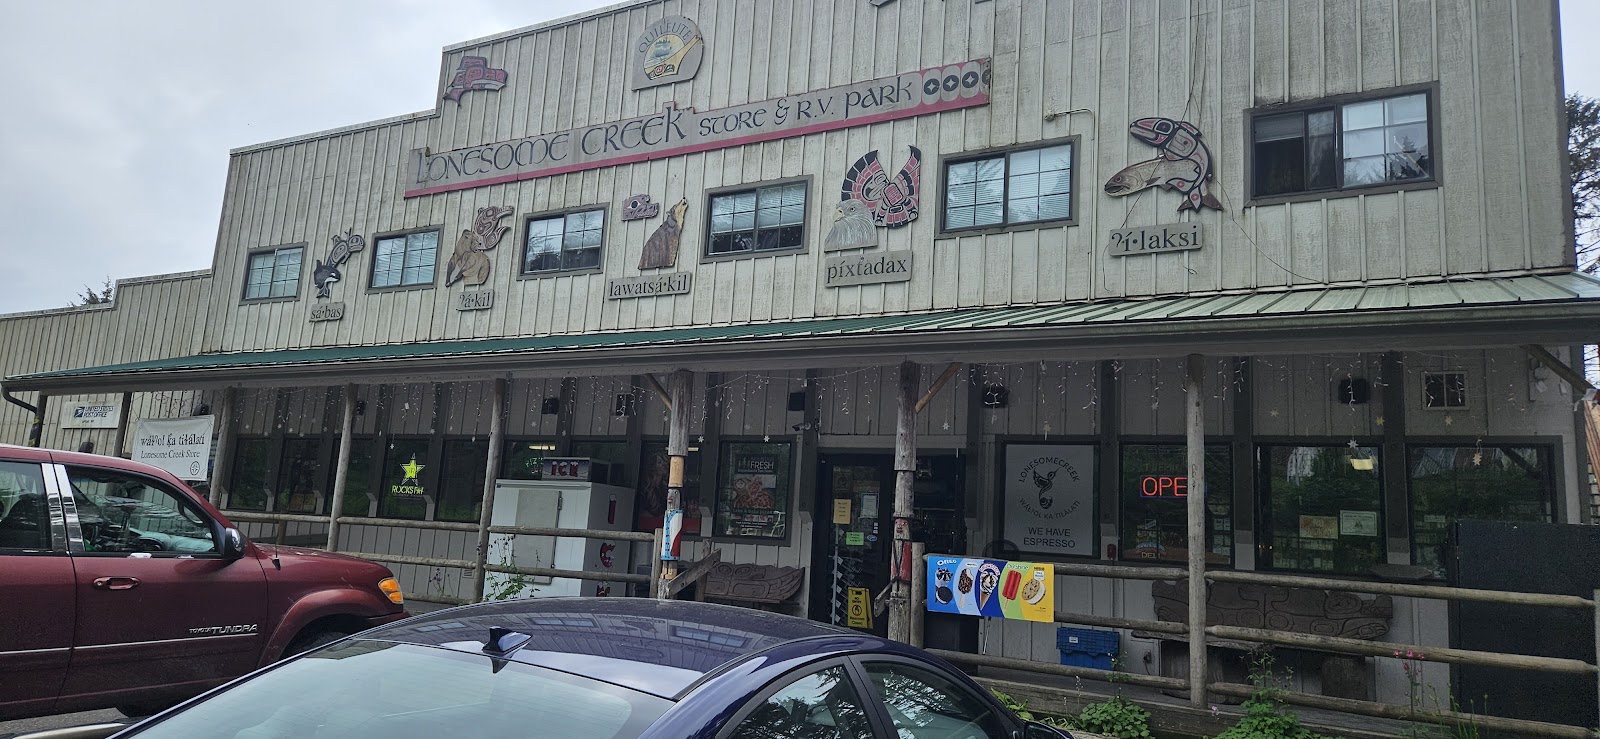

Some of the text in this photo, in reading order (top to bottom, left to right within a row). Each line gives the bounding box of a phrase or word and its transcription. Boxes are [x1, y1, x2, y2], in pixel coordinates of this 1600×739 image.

[639, 18, 692, 53] QUILEUTE
[415, 76, 913, 185] LONESOME CREEK STORE & R.V. PARK
[140, 449, 201, 459] Lonesome Creek Store
[550, 461, 579, 477] ICE
[750, 461, 774, 470] FRESH
[1142, 476, 1188, 497] OPE
[1028, 527, 1071, 537] WE HAVE
[1023, 537, 1076, 548] ESPRESSO
[211, 623, 258, 635] TUNDRA
